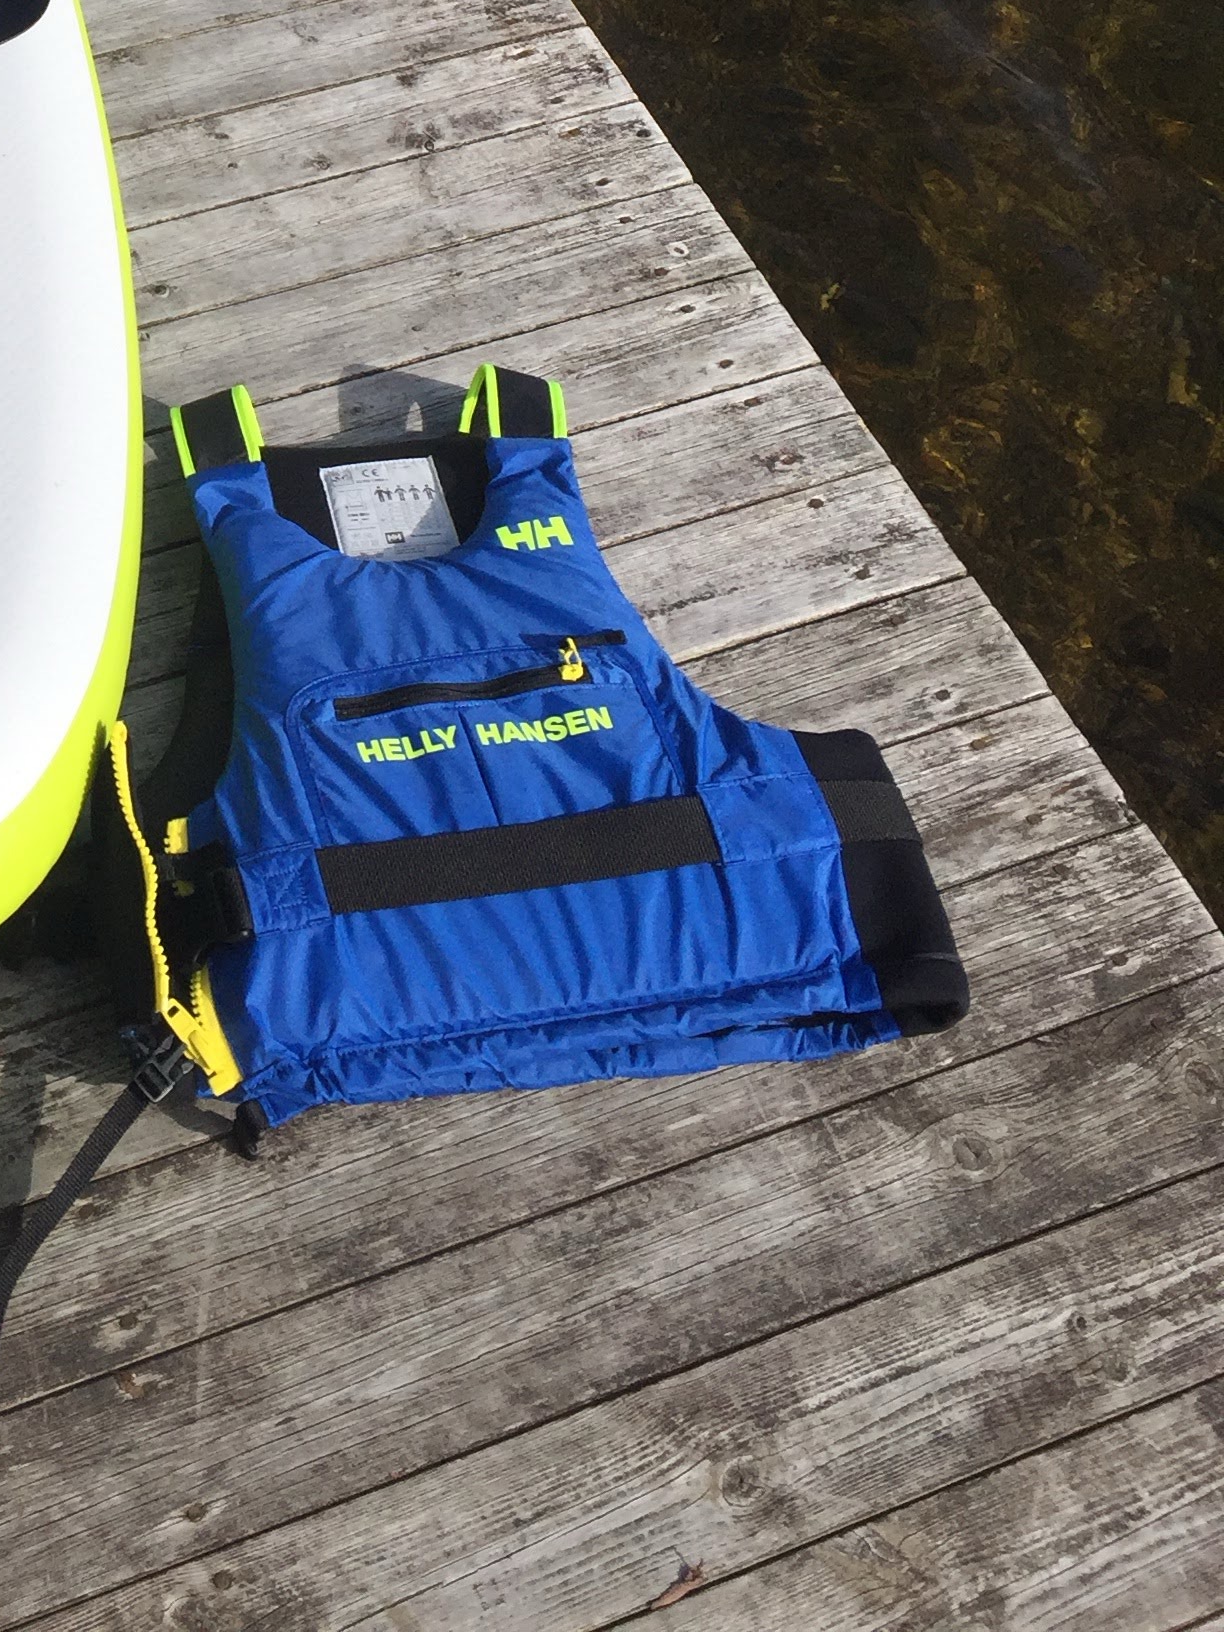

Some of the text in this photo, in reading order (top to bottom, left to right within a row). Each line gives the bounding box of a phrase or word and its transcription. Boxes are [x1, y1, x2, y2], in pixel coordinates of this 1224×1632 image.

[495, 516, 574, 551] HH
[357, 707, 613, 762] HELLY HANSEN
